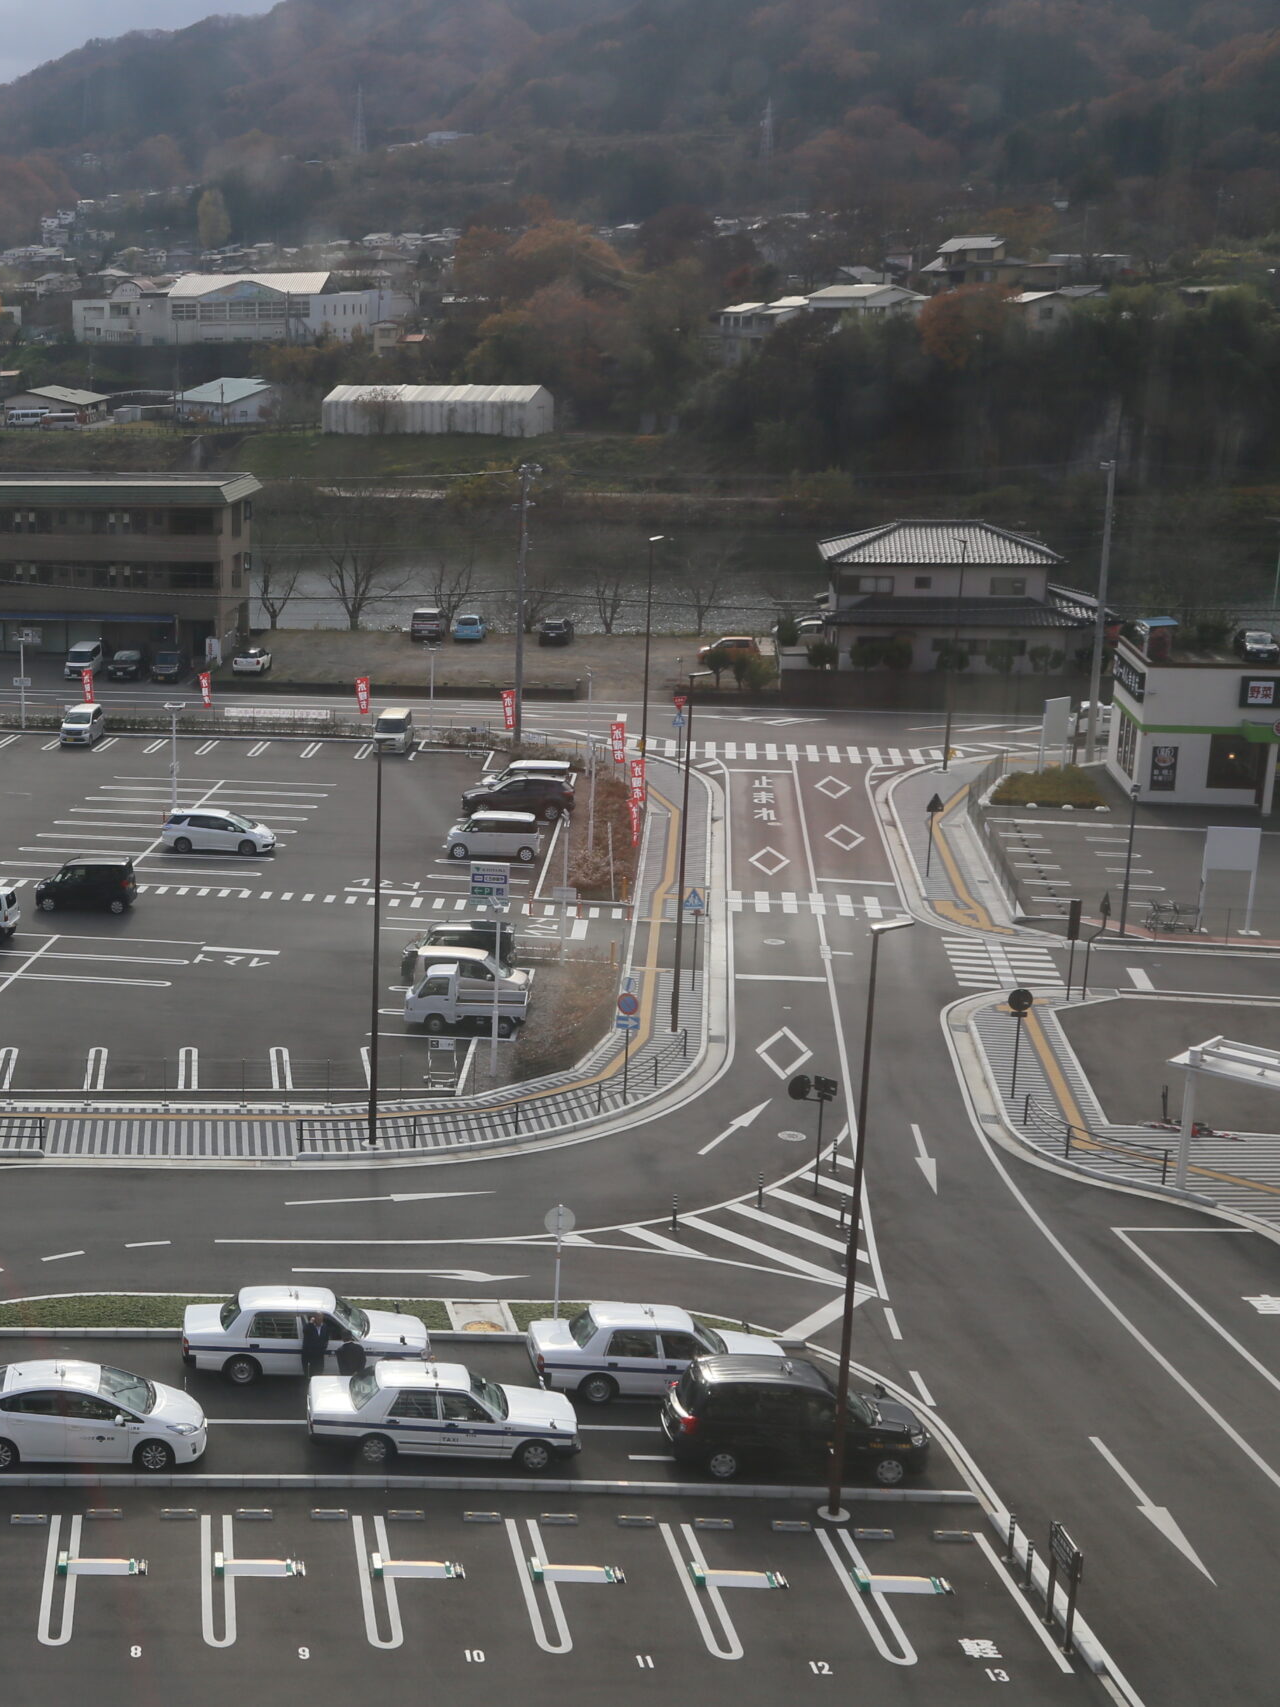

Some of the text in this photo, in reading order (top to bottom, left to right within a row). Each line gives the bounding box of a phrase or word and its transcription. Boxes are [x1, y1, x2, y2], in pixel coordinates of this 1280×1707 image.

[1249, 686, 1273, 700] 野菜
[752, 775, 777, 821] 止まれ
[192, 953, 271, 968] トマレ
[130, 1645, 142, 1658] 8
[298, 1647, 310, 1660] 9
[464, 1649, 486, 1663] 10
[635, 1655, 655, 1669] 11
[809, 1661, 833, 1675] 12
[984, 1668, 1010, 1682] 13
